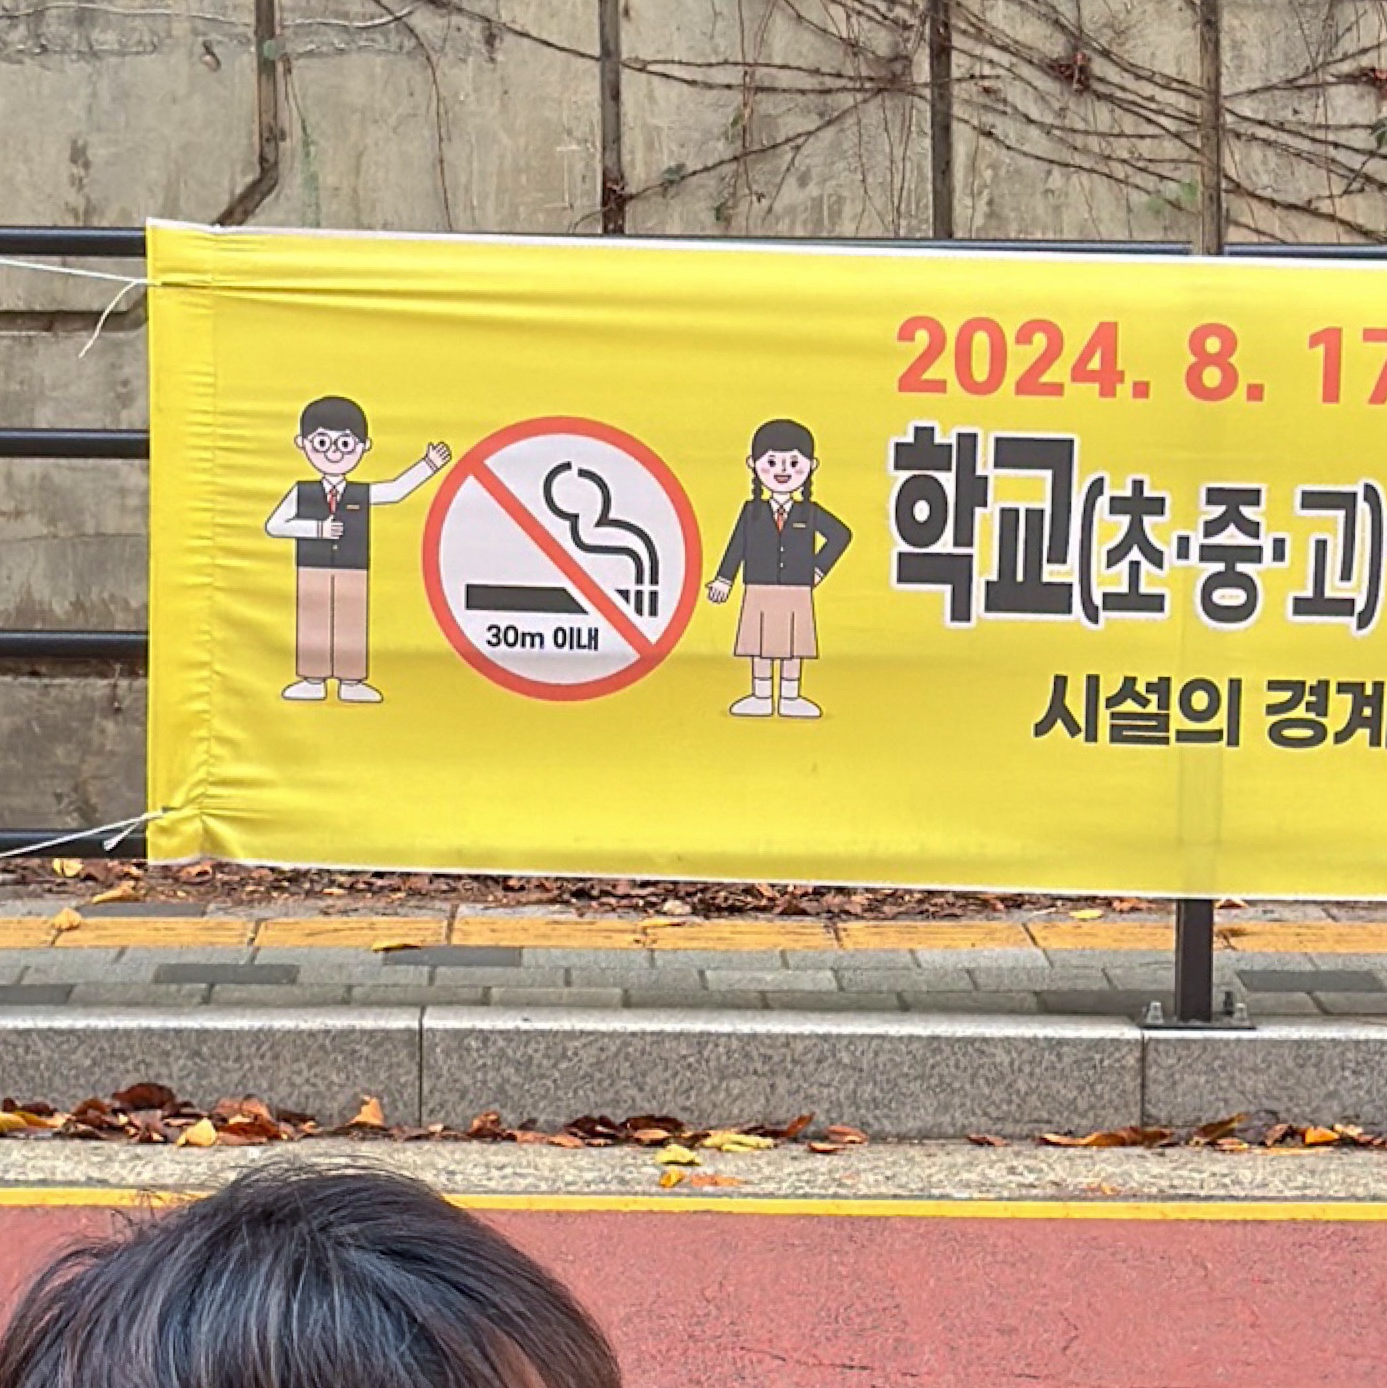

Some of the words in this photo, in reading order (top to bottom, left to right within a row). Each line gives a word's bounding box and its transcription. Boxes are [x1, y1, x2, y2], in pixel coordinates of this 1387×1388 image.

[895, 316, 1150, 400] 2024.
[1184, 322, 1265, 402] 8.
[485, 624, 545, 649] 30m
[553, 626, 600, 652] 이내
[1033, 673, 1241, 748] 시설의
